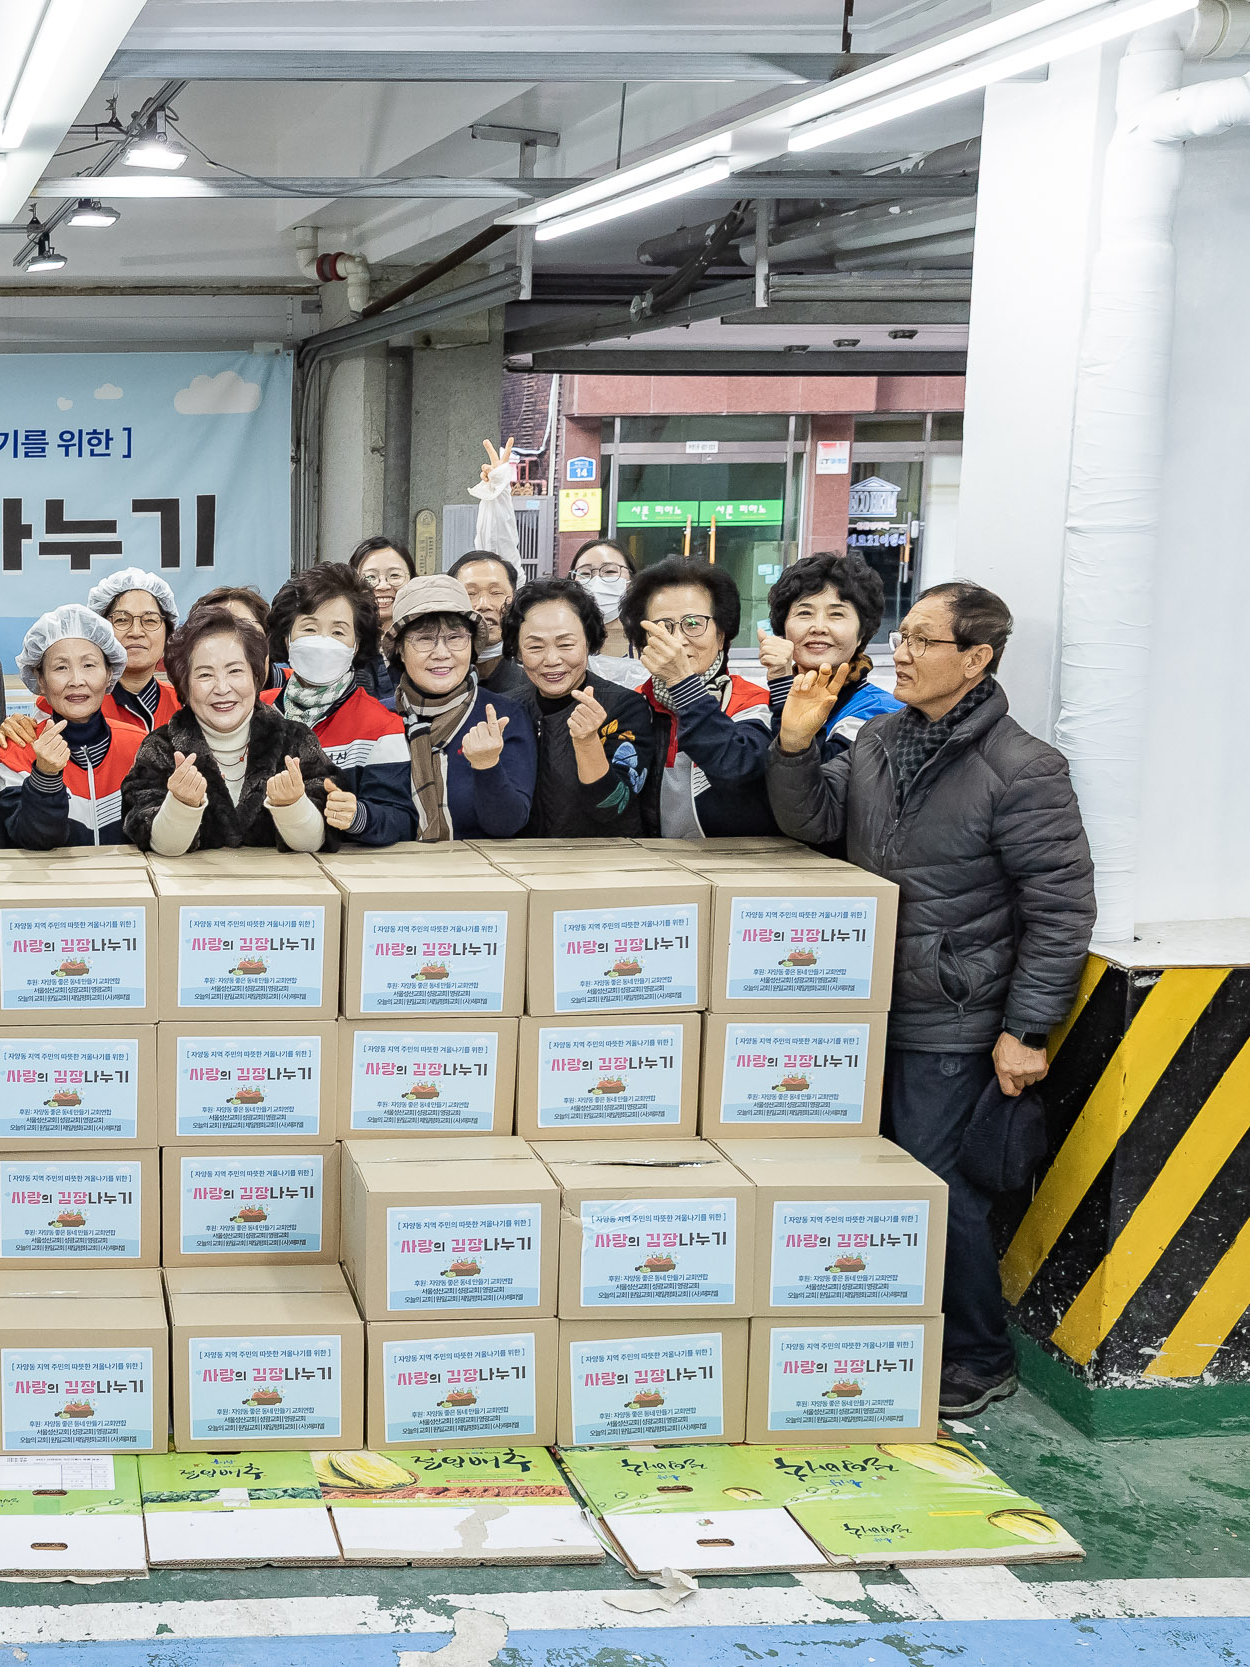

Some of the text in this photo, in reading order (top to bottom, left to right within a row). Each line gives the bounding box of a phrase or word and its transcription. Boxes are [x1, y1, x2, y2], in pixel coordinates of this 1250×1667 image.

[56, 427, 115, 459] 위한
[575, 467, 588, 478] 14
[742, 927, 866, 943] 사랑의 김장나누기
[191, 936, 315, 952] 사랑의 김장나누기
[374, 942, 498, 957] 사랑의 김장나누기
[365, 1061, 488, 1077] 사랑의 김장나누기
[736, 1053, 859, 1069] 사랑의 김장나누기
[189, 1066, 312, 1082] 사랑의 김장나누기
[11, 1191, 133, 1206] 사랑의 김장나누기
[192, 1185, 314, 1201] 사랑의 김장나누기
[400, 1236, 532, 1254] 사랑의 김장나누기
[594, 1231, 727, 1249] 사랑의 김장나누기
[785, 1232, 918, 1249] 사랑의 김장나누기
[202, 1366, 332, 1383] 사랑의 김장나누기
[783, 1358, 914, 1375] 사랑의 김장나누기
[397, 1365, 526, 1387] 사랑의 김장나누기
[584, 1365, 714, 1387] 사랑의 김장나누기
[14, 1379, 144, 1395] 사랑의 김장나누기
[411, 1447, 533, 1472] 절임배추
[621, 1456, 705, 1476] 절임배추
[178, 1462, 265, 1480] 절임배추
[775, 1456, 900, 1481] 절임배추
